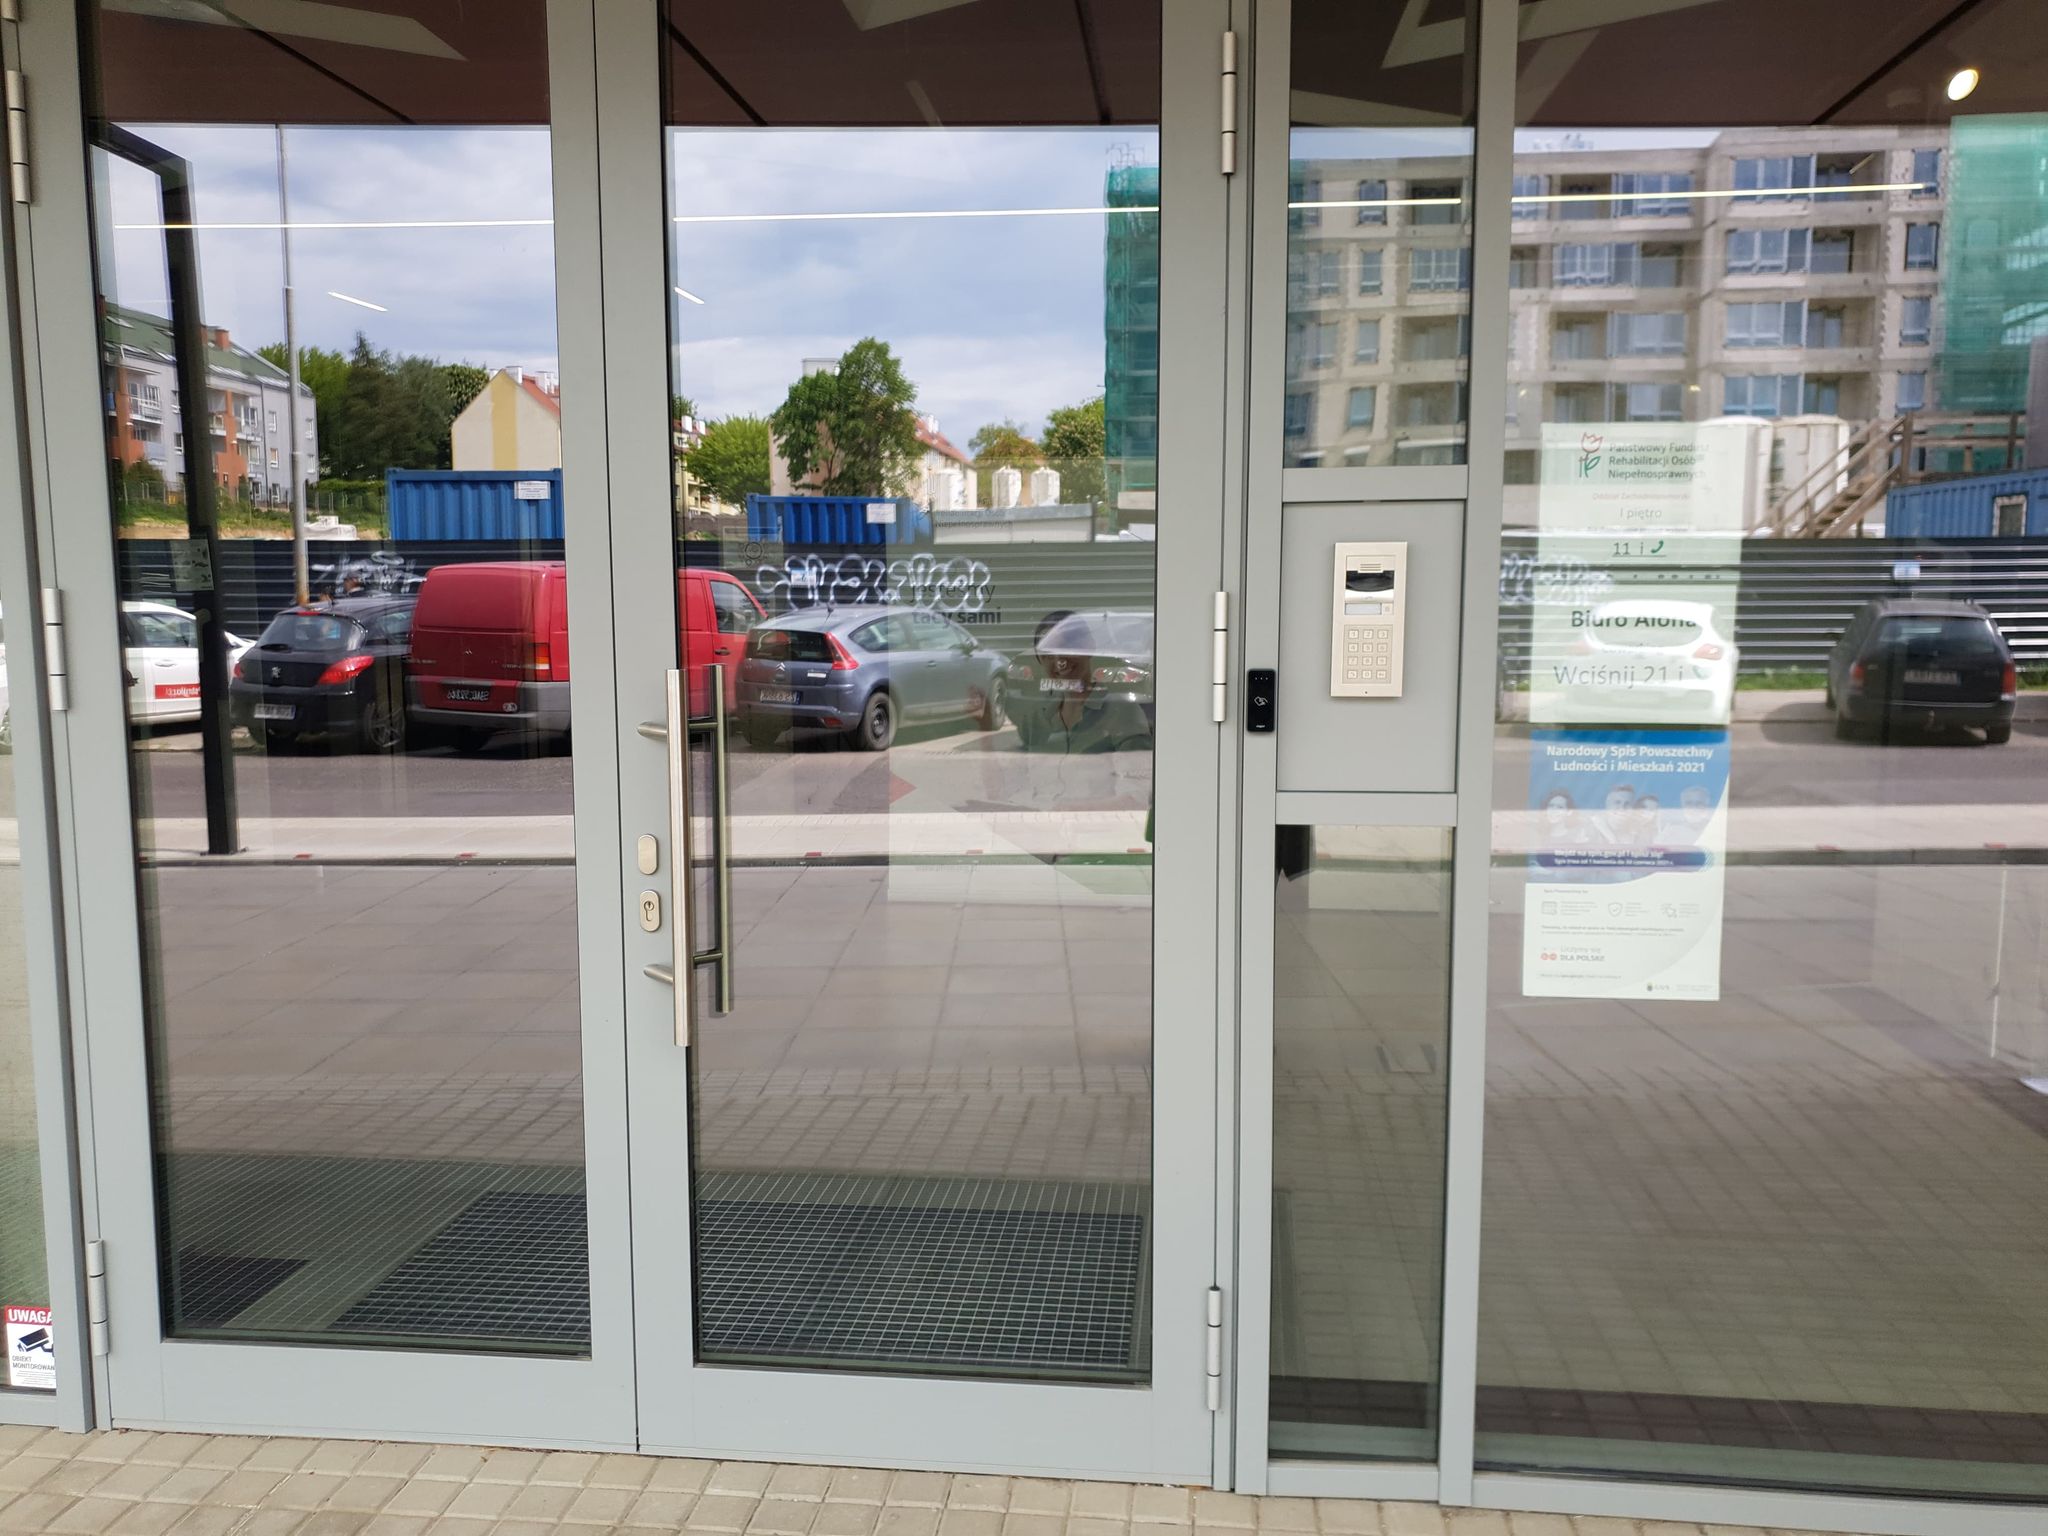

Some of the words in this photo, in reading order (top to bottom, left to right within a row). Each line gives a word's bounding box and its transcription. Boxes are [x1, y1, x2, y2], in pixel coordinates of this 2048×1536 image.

[1609, 455, 1669, 467] Rehabilitacji
[1671, 455, 1696, 465] Osób
[1627, 509, 1662, 520] piętro
[1613, 542, 1630, 555] 11
[956, 606, 1001, 624] sami
[1571, 610, 1628, 627] Biuro
[1553, 664, 1635, 689] Wciśnij
[1546, 745, 1608, 758] Narodowy
[1610, 745, 1637, 759] Spis
[1639, 746, 1714, 760] Powszechny
[1554, 760, 1608, 772] Ludności
[1610, 760, 1614, 771] i
[1616, 760, 1674, 773] Mieszkań
[1677, 762, 1705, 773] 2021
